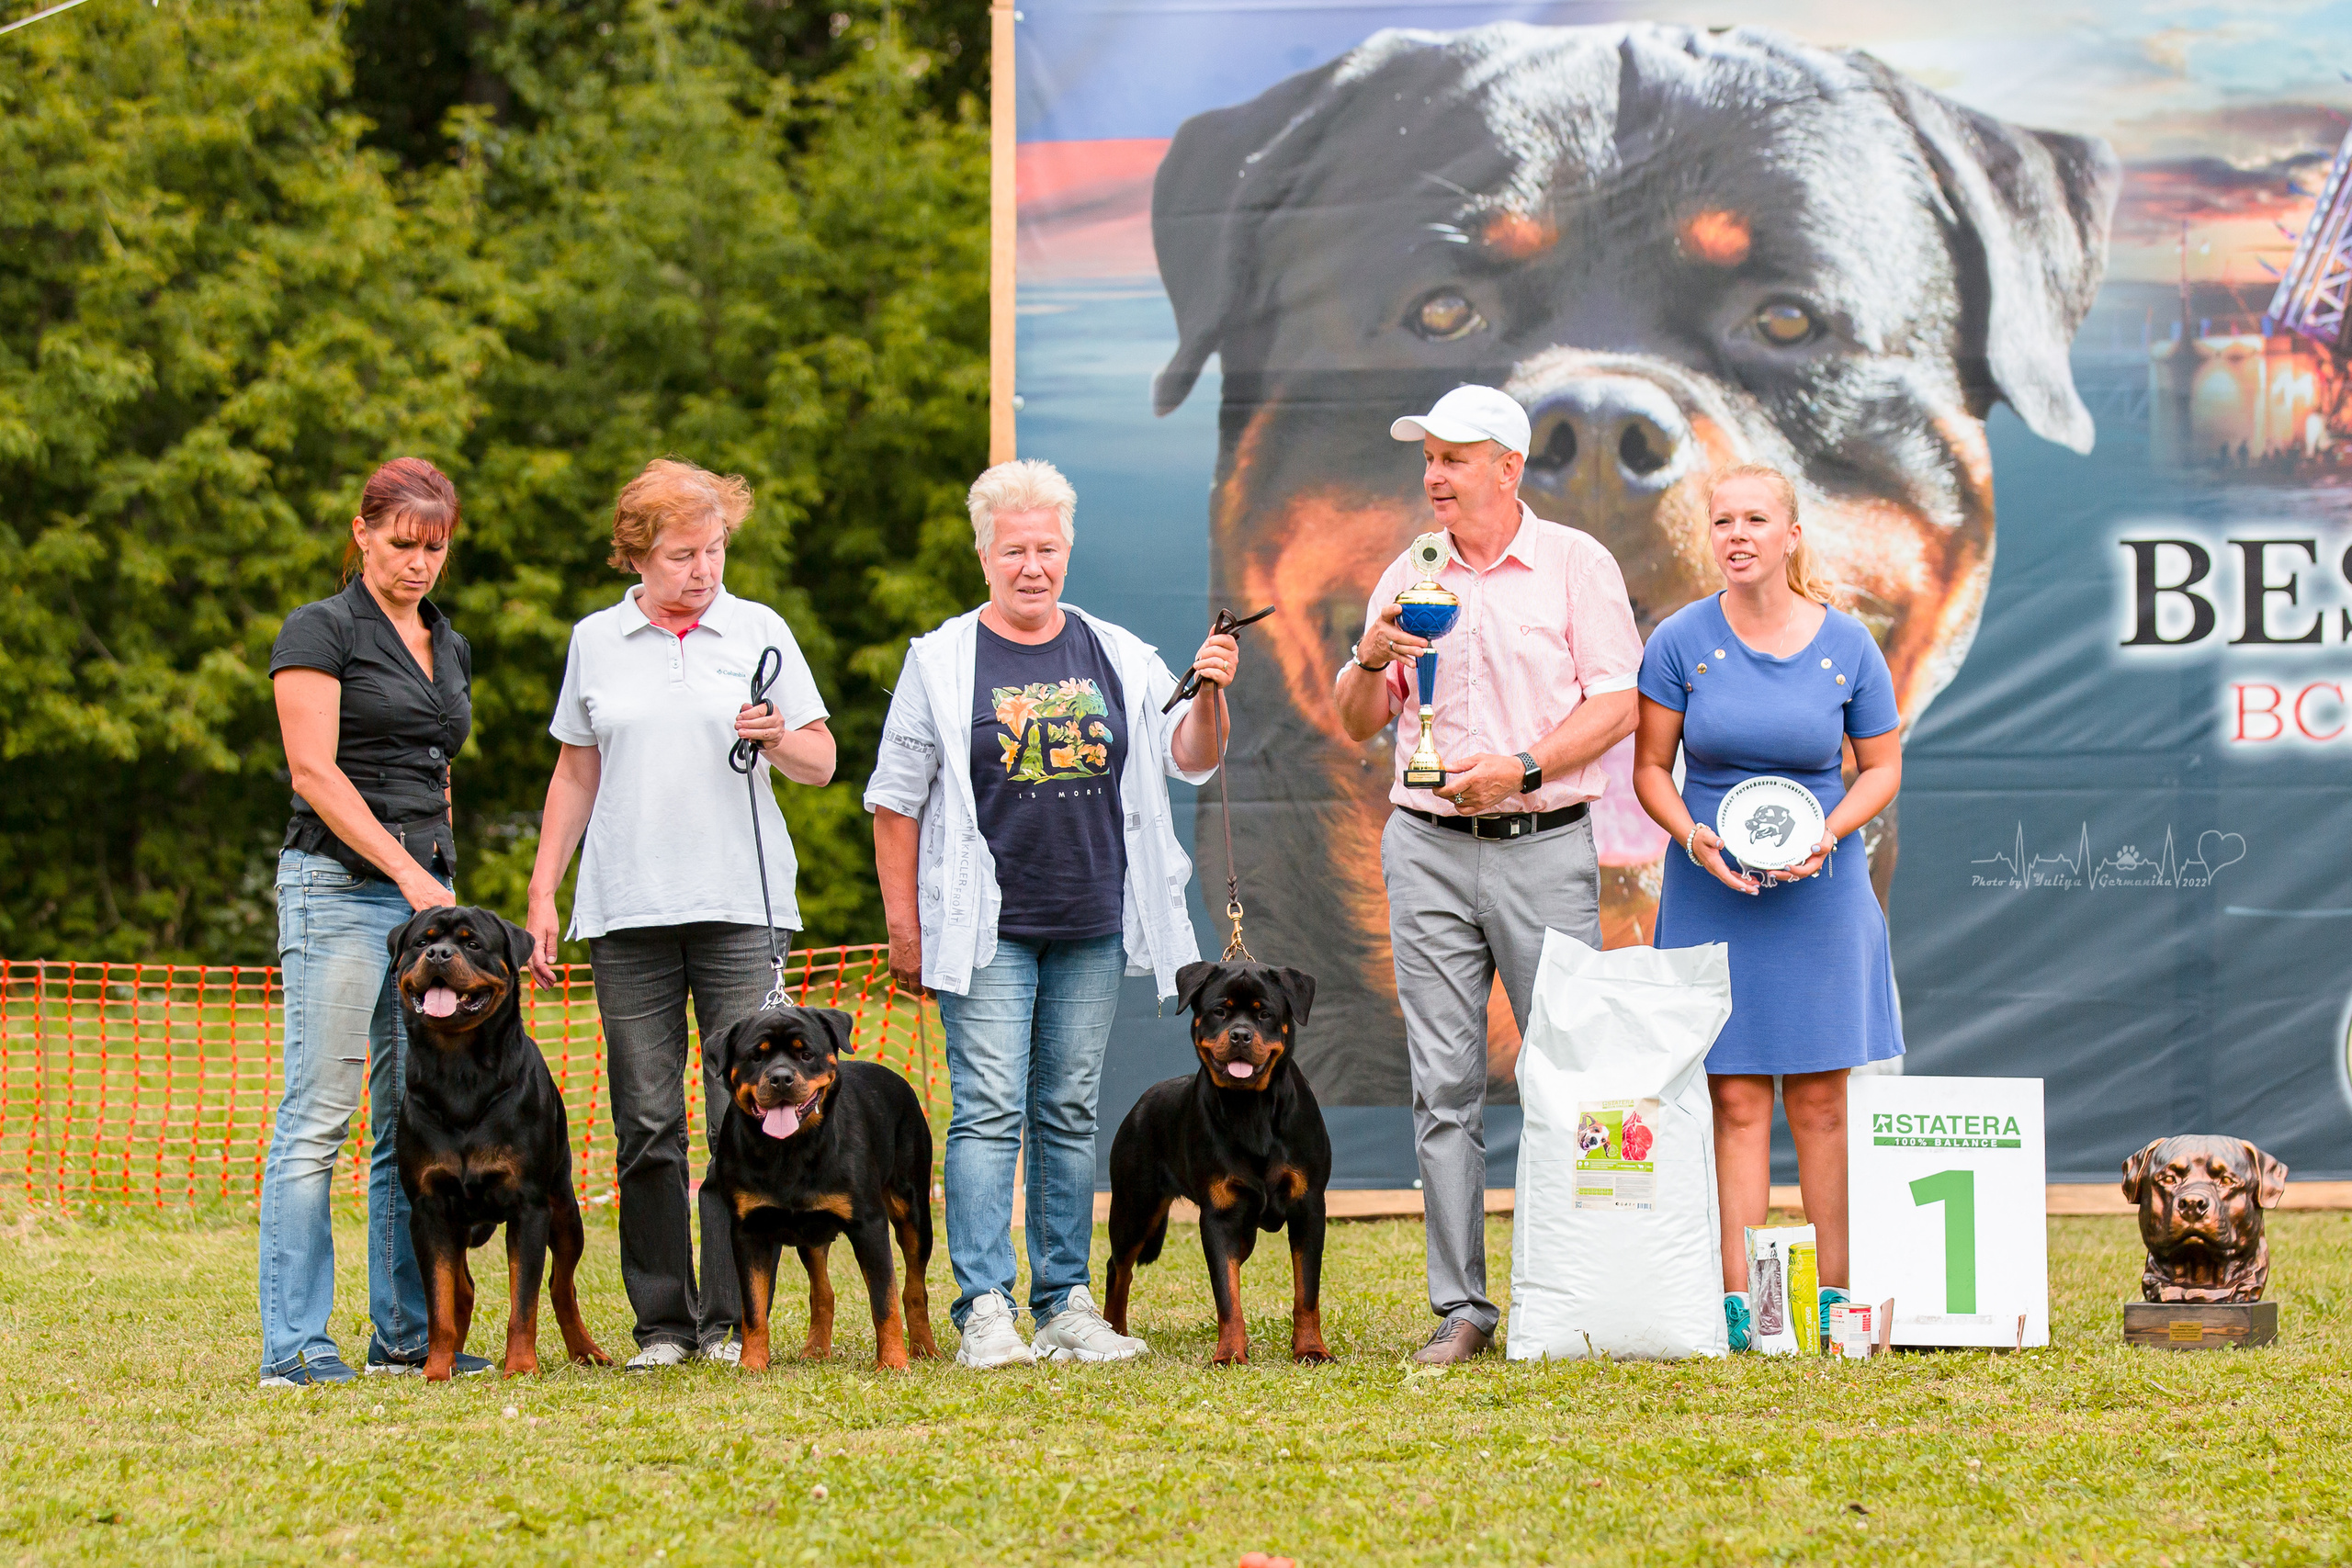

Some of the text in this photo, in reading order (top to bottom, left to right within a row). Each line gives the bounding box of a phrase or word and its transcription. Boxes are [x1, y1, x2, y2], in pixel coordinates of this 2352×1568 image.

[2120, 539, 2352, 647] BE
[1019, 787, 1102, 799] IS MORE
[1895, 1113, 2021, 1135] STATERA
[1894, 1137, 1998, 1147] 100% BALANCE
[1909, 1169, 1976, 1314] 1
